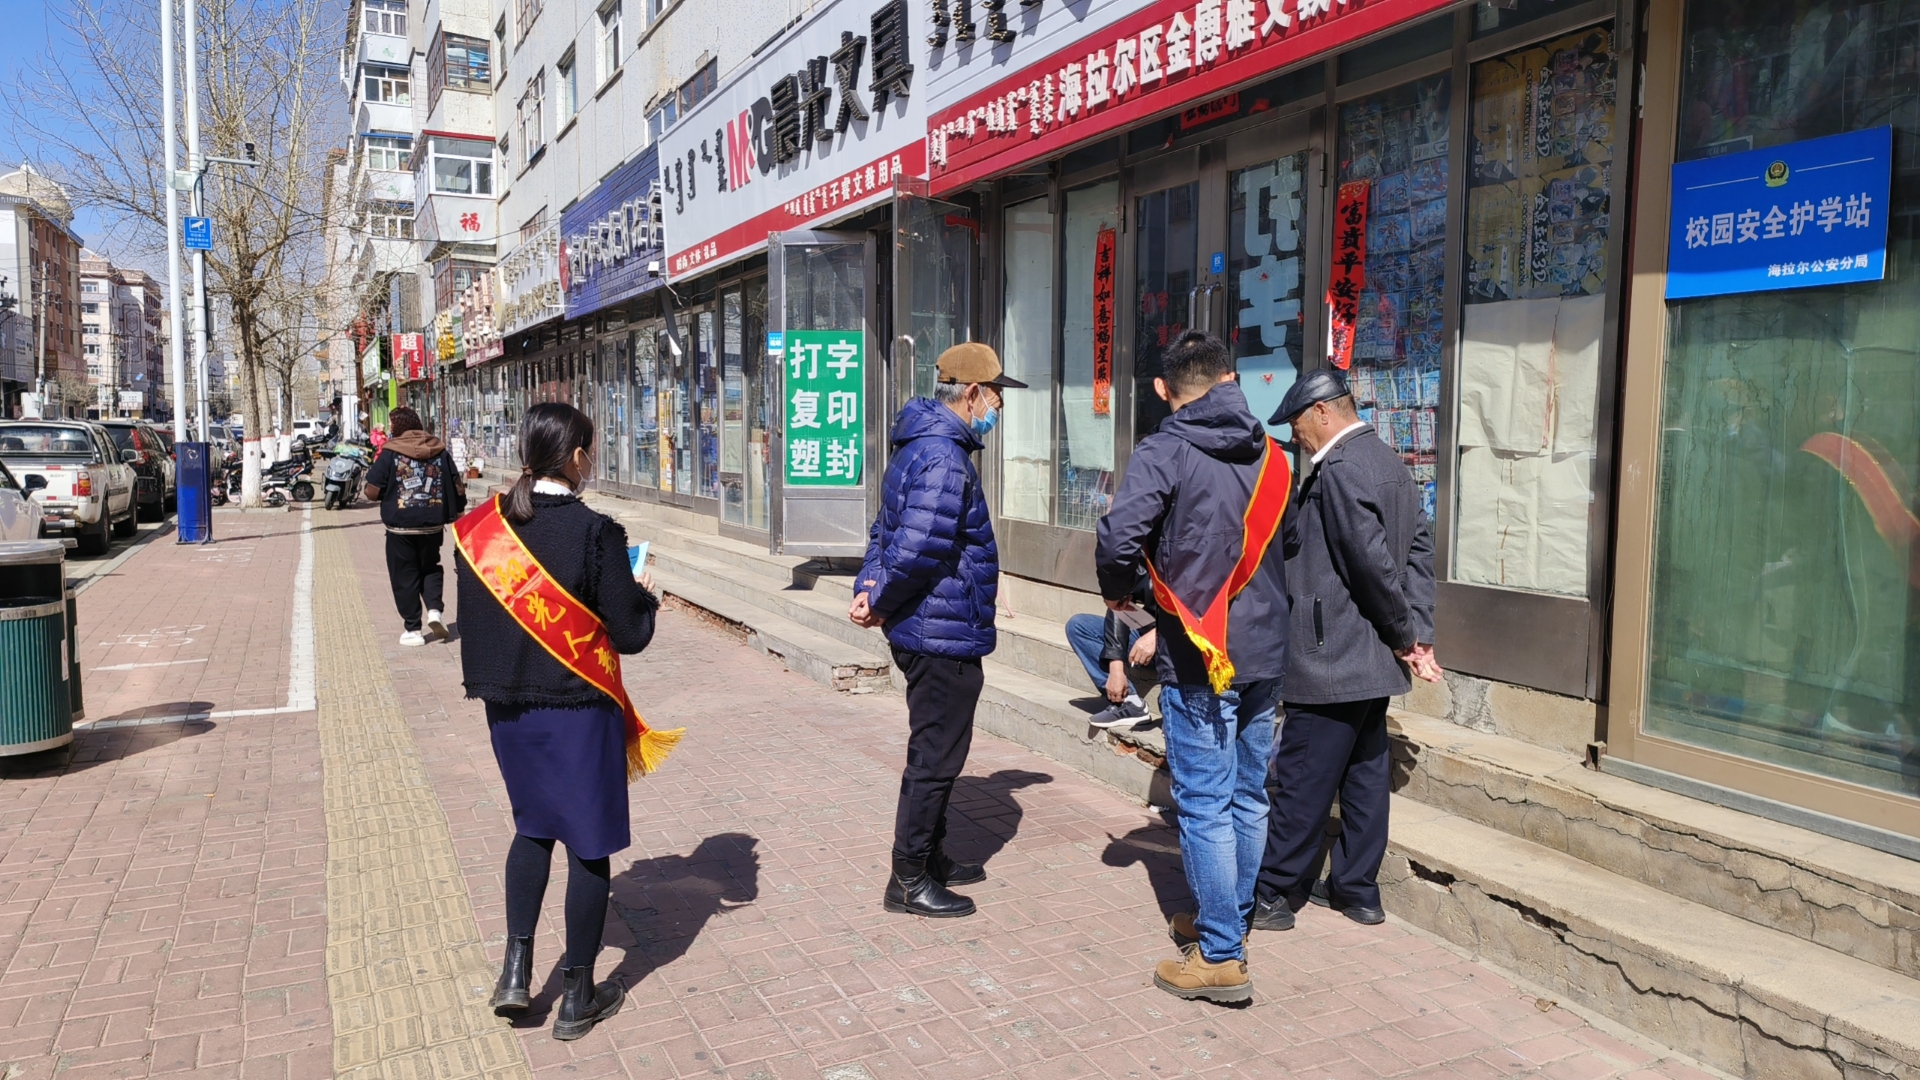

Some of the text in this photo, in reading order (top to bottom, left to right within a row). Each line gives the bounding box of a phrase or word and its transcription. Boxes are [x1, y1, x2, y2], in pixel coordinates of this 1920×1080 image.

[771, 0, 914, 164] 晨光文具
[1058, 0, 1347, 122] 海拉尔区金博雅文
[727, 97, 777, 193] M&G
[459, 211, 481, 233] 福
[1532, 192, 1550, 283] 全息立体3D
[1685, 192, 1872, 249] 校园安全护学站
[1767, 253, 1869, 277] 海拉尔公安分局
[1095, 244, 1112, 385] 吉祥如意福星照
[400, 334, 417, 351] 超
[789, 339, 859, 380] 打字
[789, 388, 858, 429] 复印
[789, 438, 860, 479] 塑封
